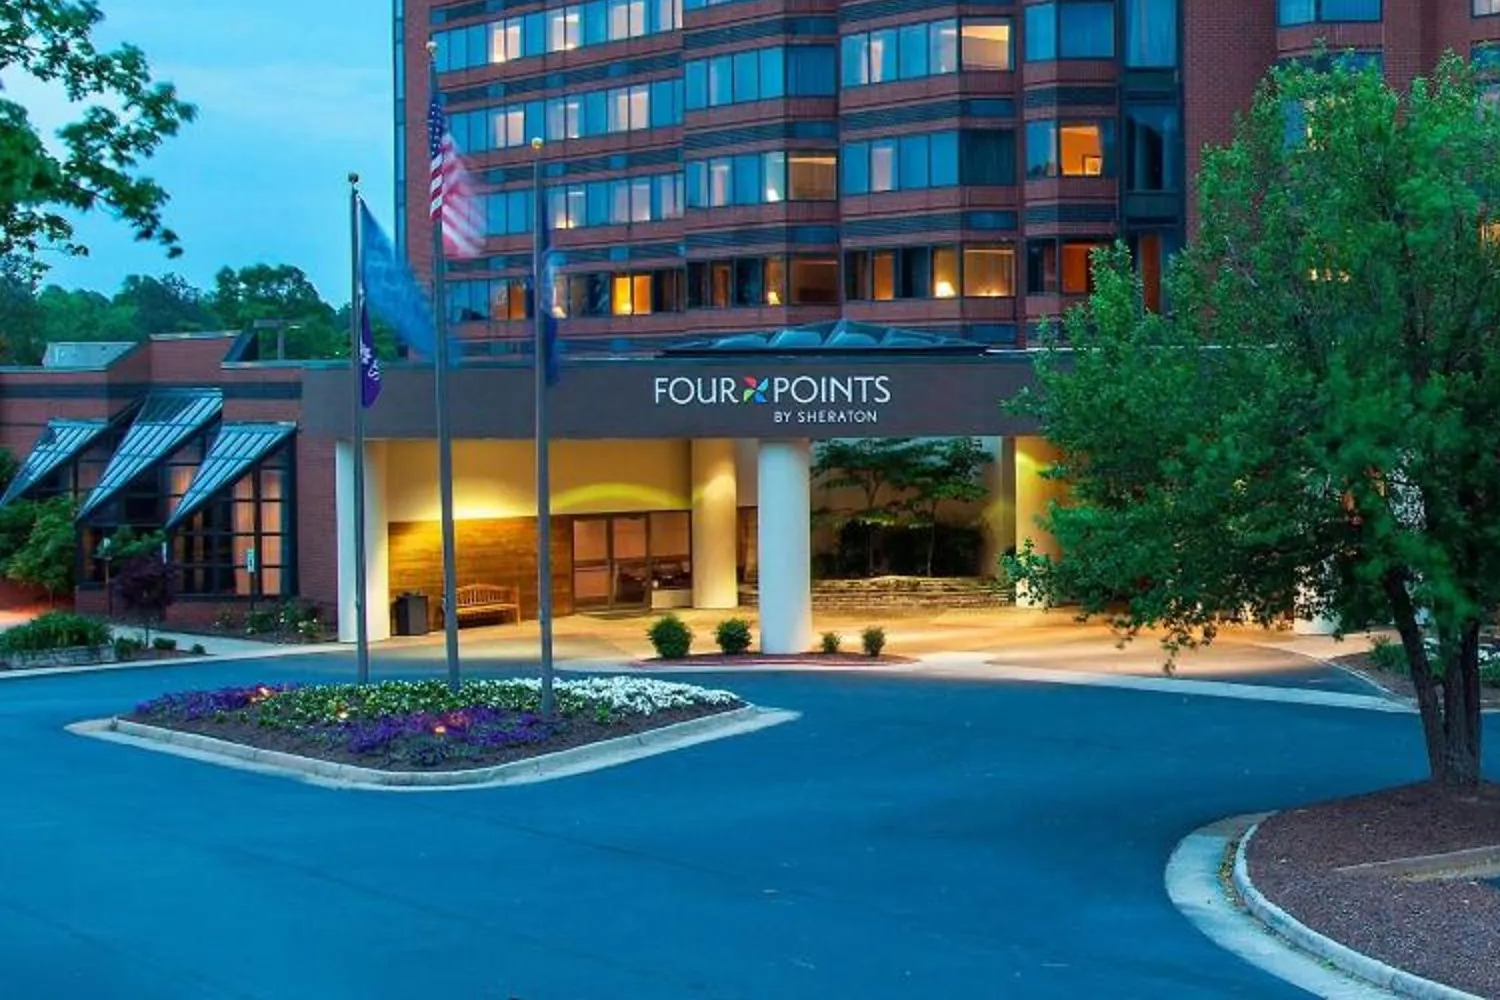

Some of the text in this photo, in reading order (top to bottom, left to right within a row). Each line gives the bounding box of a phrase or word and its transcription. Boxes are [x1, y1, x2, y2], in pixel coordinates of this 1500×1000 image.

[655, 376, 891, 404] FOUR POINTS
[774, 410, 877, 423] BY SHERATON
